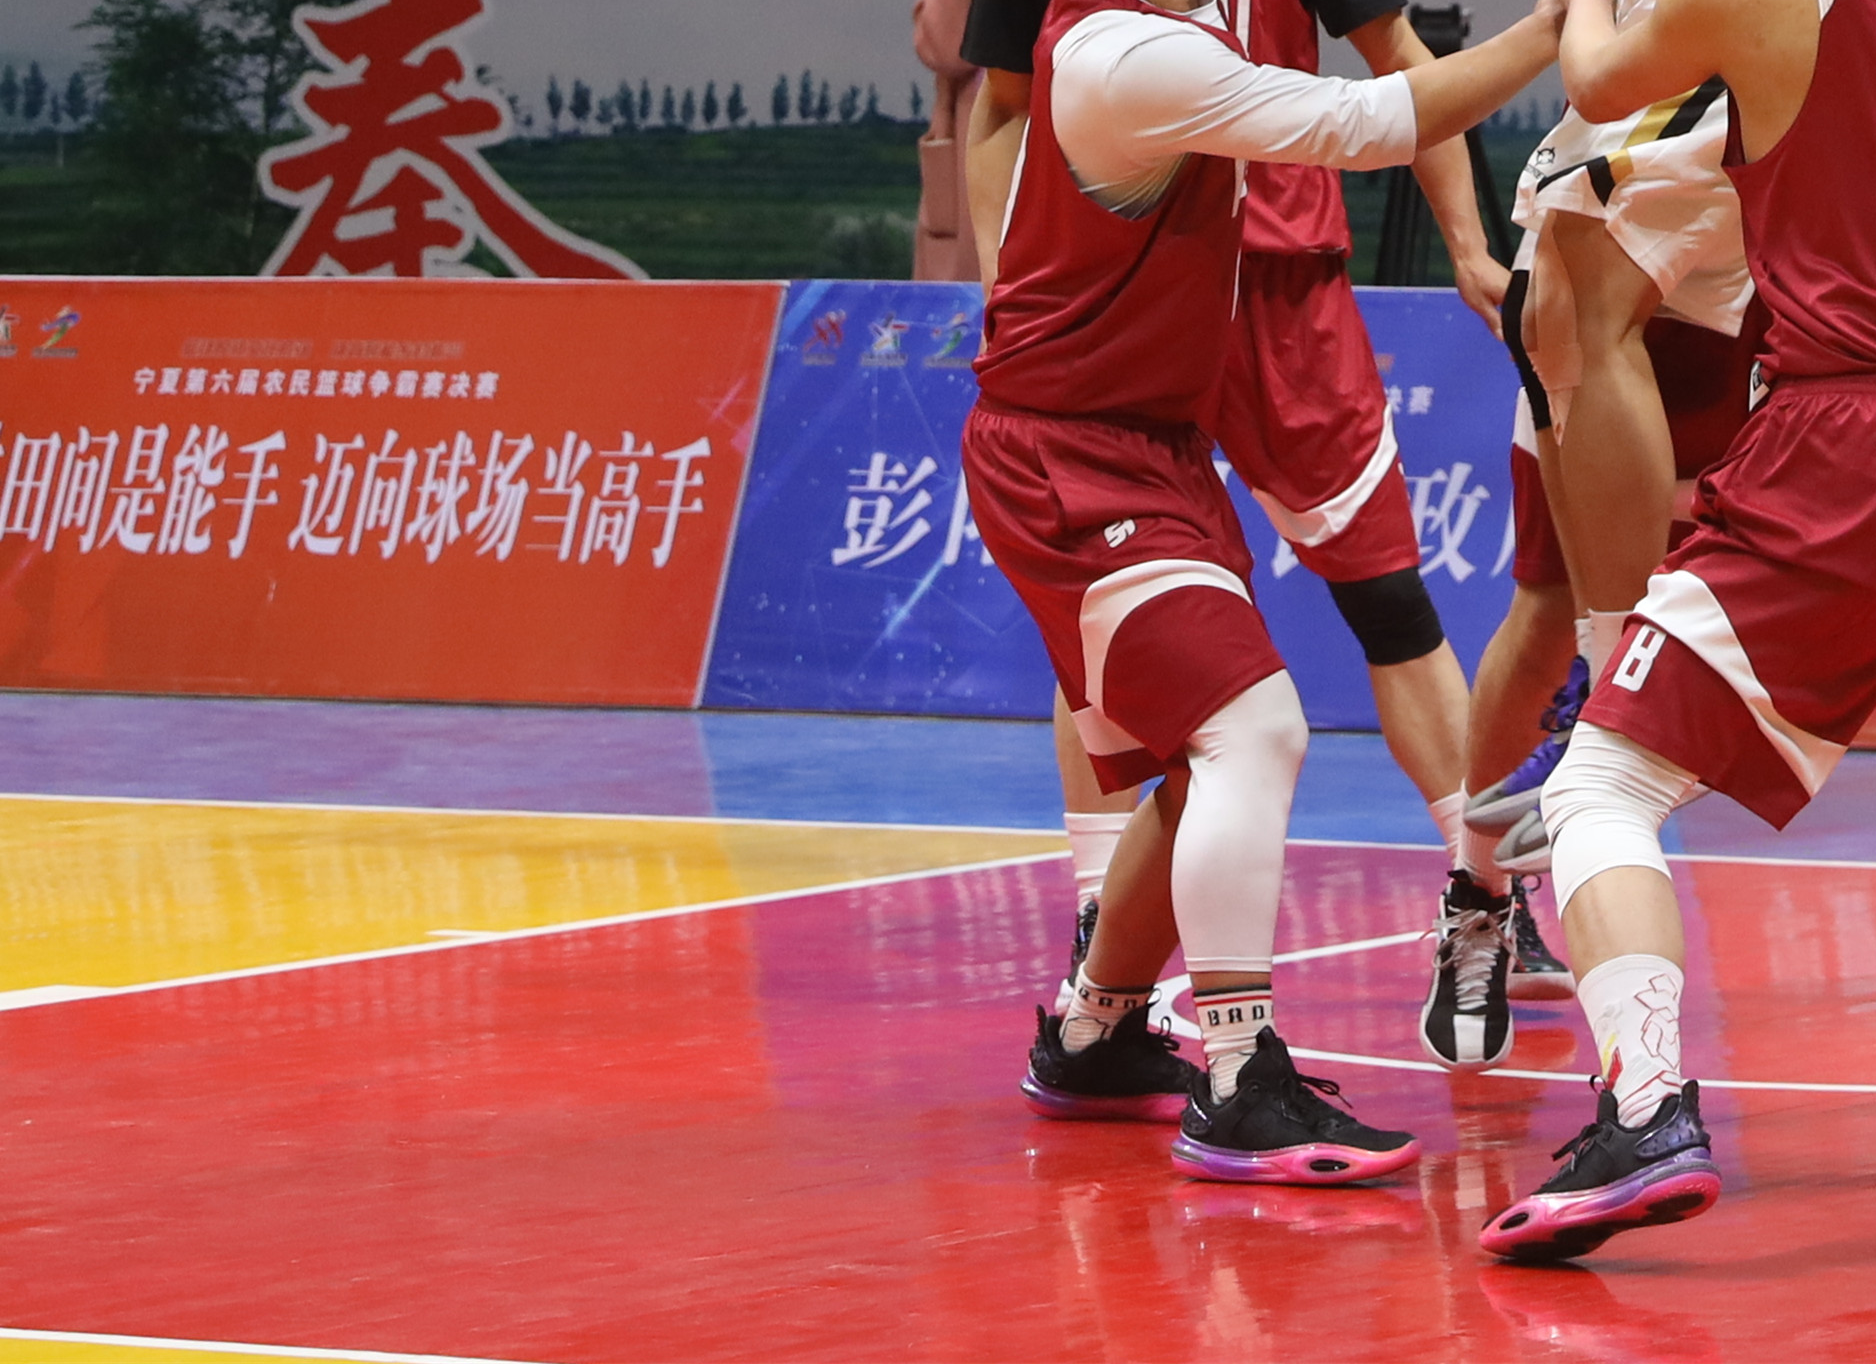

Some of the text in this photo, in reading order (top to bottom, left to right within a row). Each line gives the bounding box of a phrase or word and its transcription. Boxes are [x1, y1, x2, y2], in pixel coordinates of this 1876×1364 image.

[133, 366, 500, 400] 宁夏第六届农民篮球争霸赛决赛
[0, 421, 713, 568] 田间是能手 迈向球场当高手
[1611, 623, 1668, 693] 8
